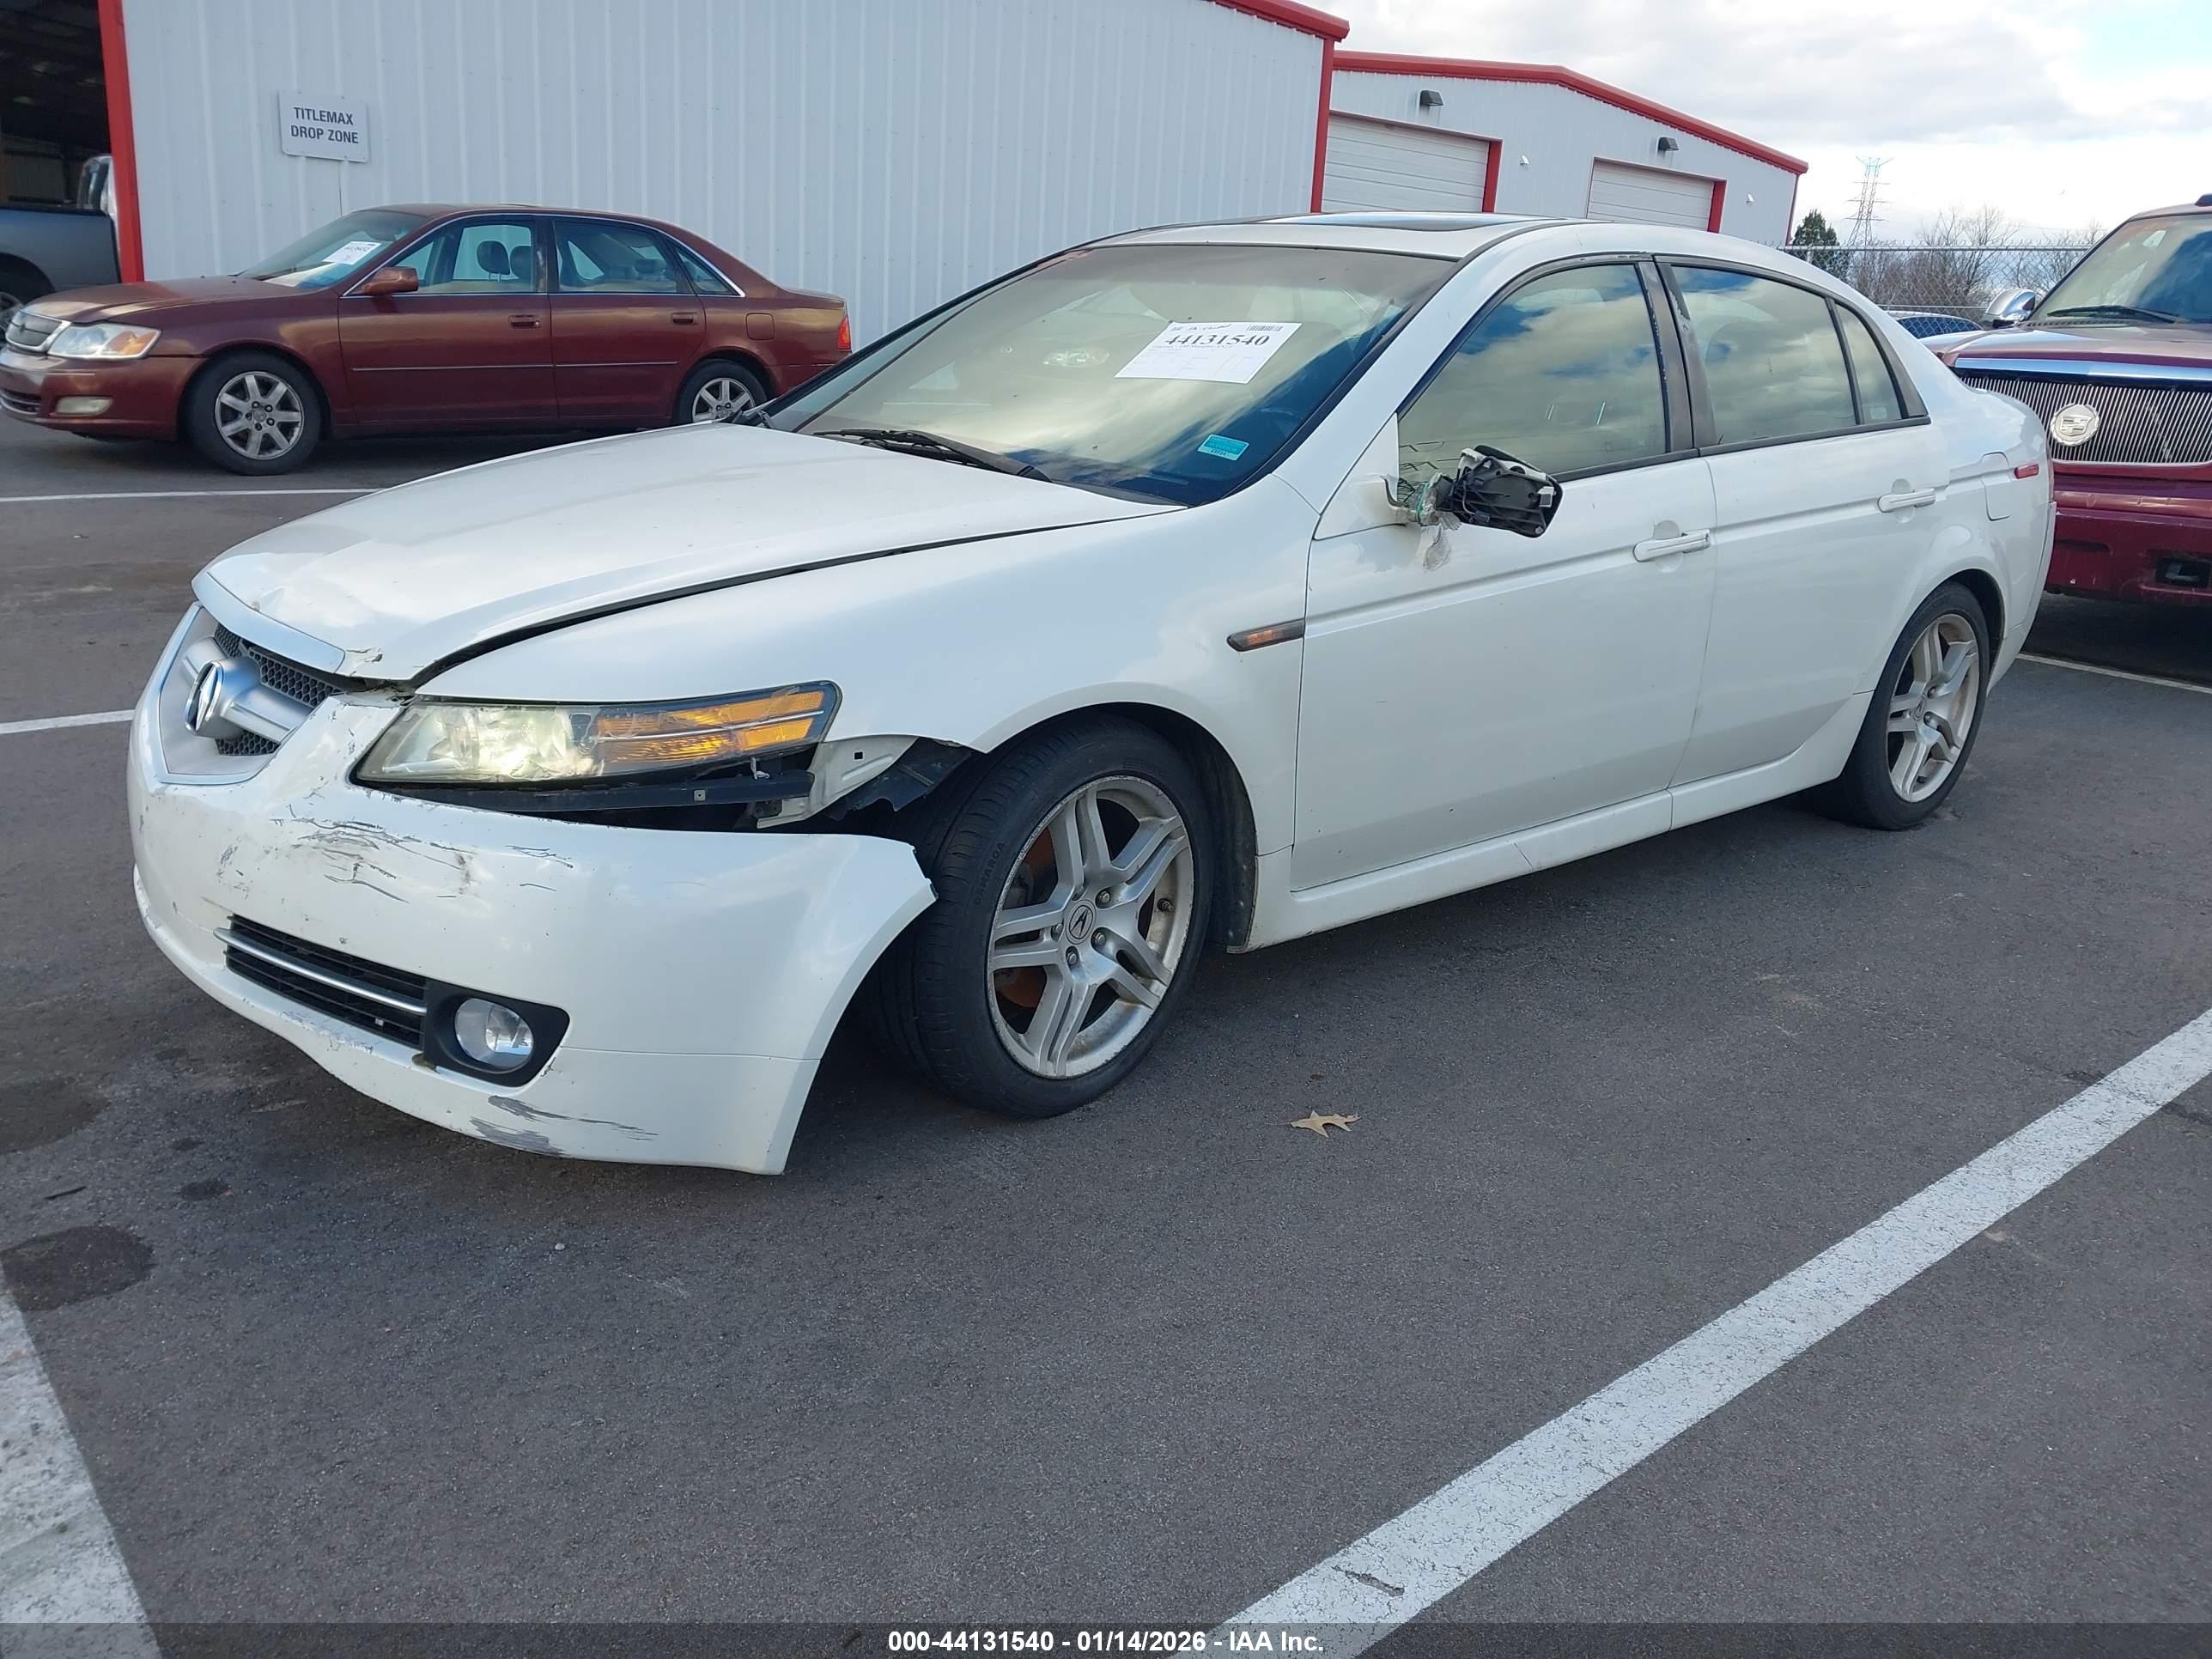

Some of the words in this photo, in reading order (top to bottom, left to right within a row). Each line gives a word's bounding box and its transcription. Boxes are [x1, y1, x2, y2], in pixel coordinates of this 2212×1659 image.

[293, 106, 354, 125] TITLEMAX
[290, 125, 324, 140] DROP
[327, 129, 360, 144] ZONE
[1164, 334, 1270, 346] 44131540
